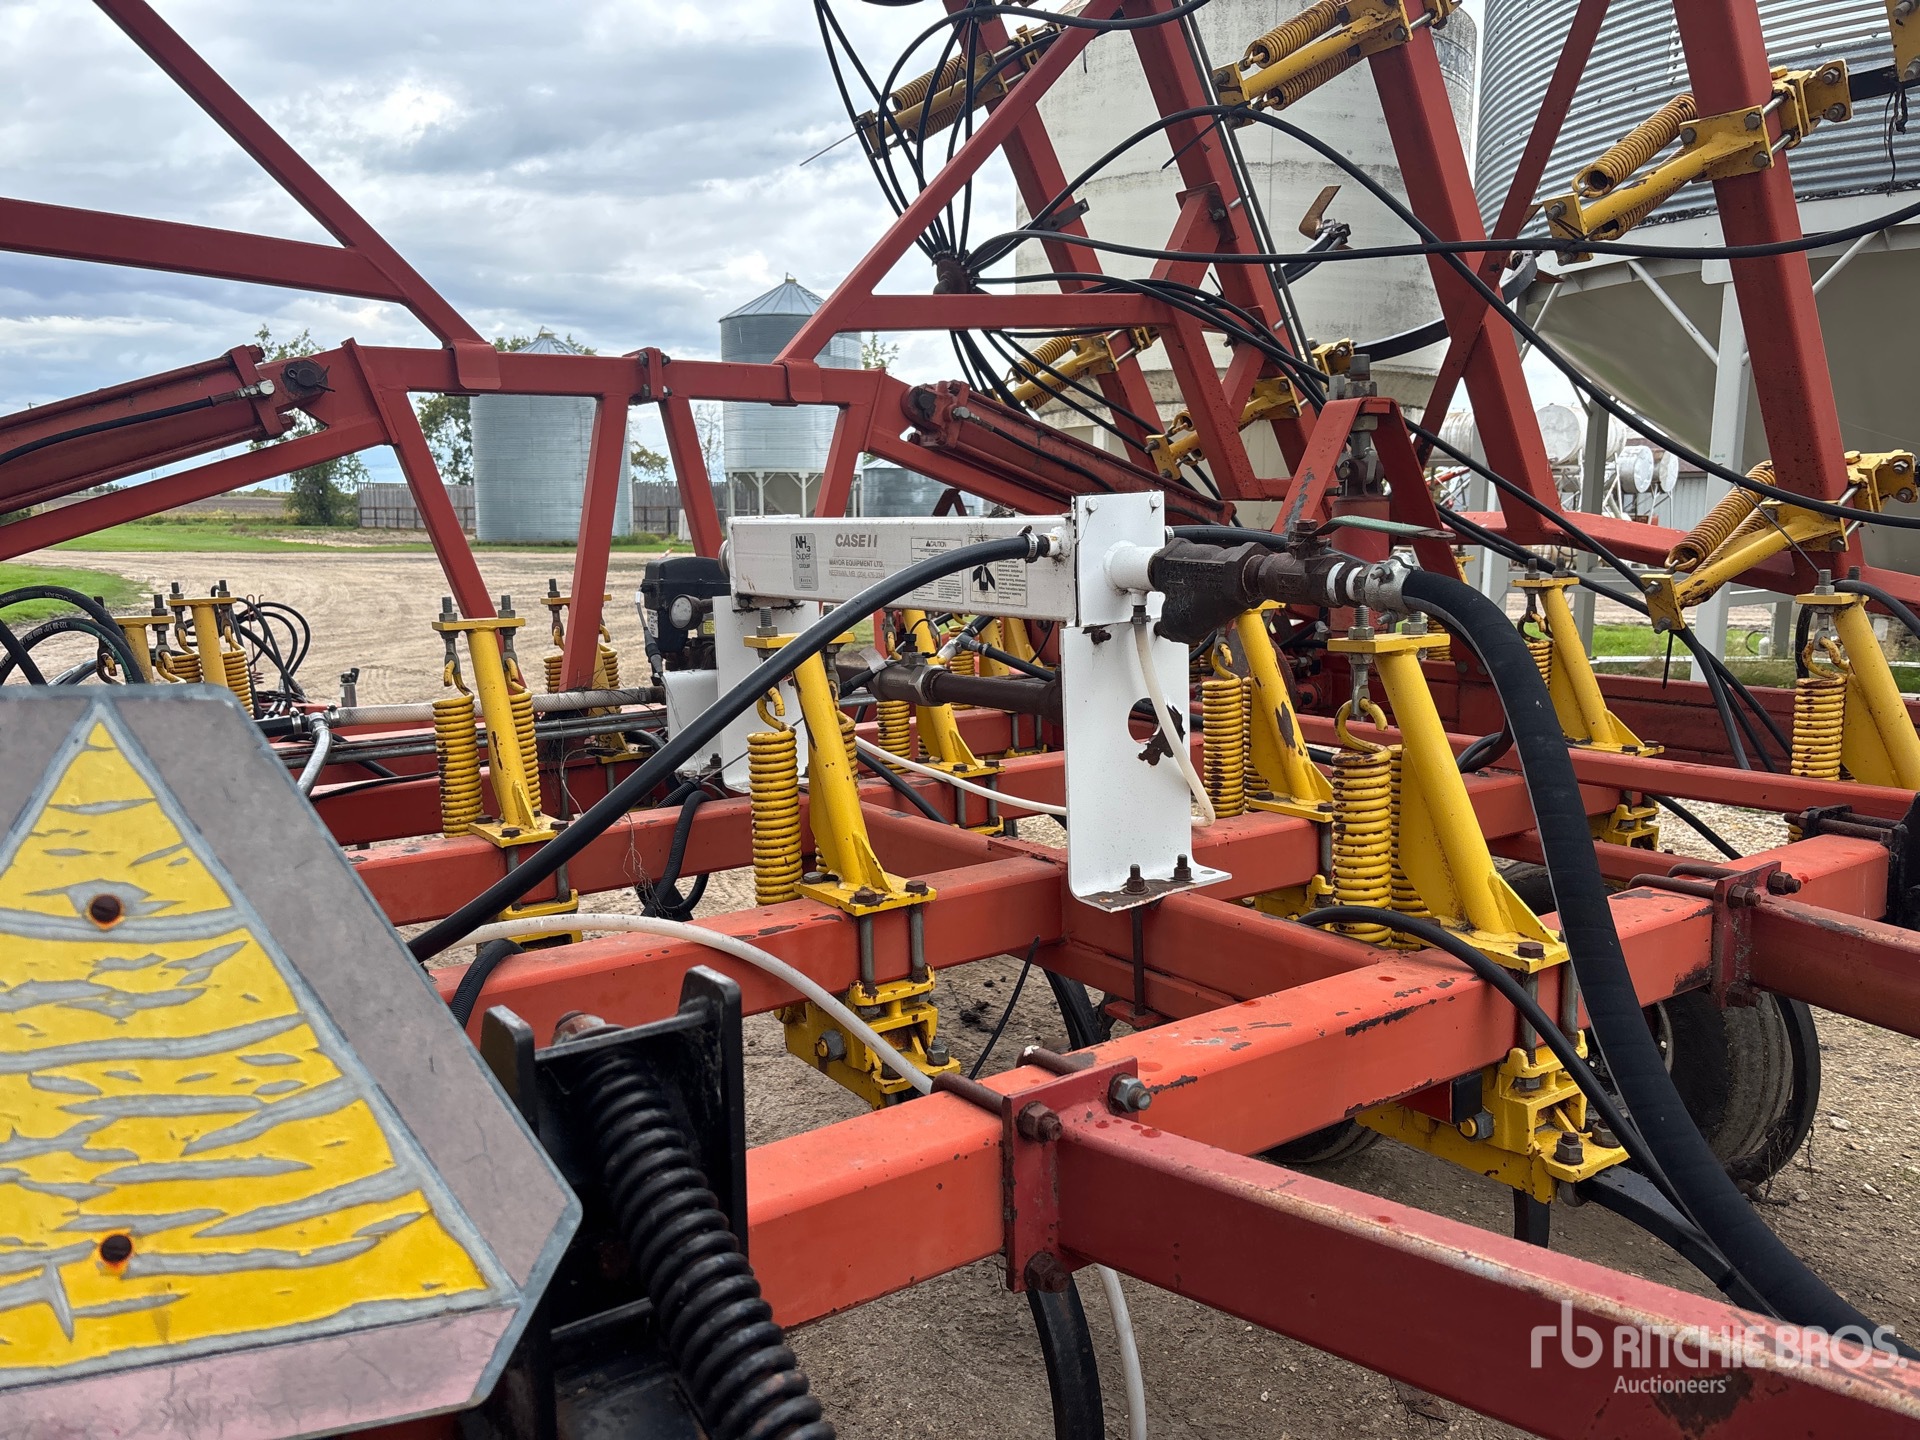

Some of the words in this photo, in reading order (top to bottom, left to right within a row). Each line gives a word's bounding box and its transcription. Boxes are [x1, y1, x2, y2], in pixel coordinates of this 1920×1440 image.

[836, 534, 866, 547] CASE
[795, 550, 811, 560] Super
[846, 560, 873, 568] EQUIPMENT
